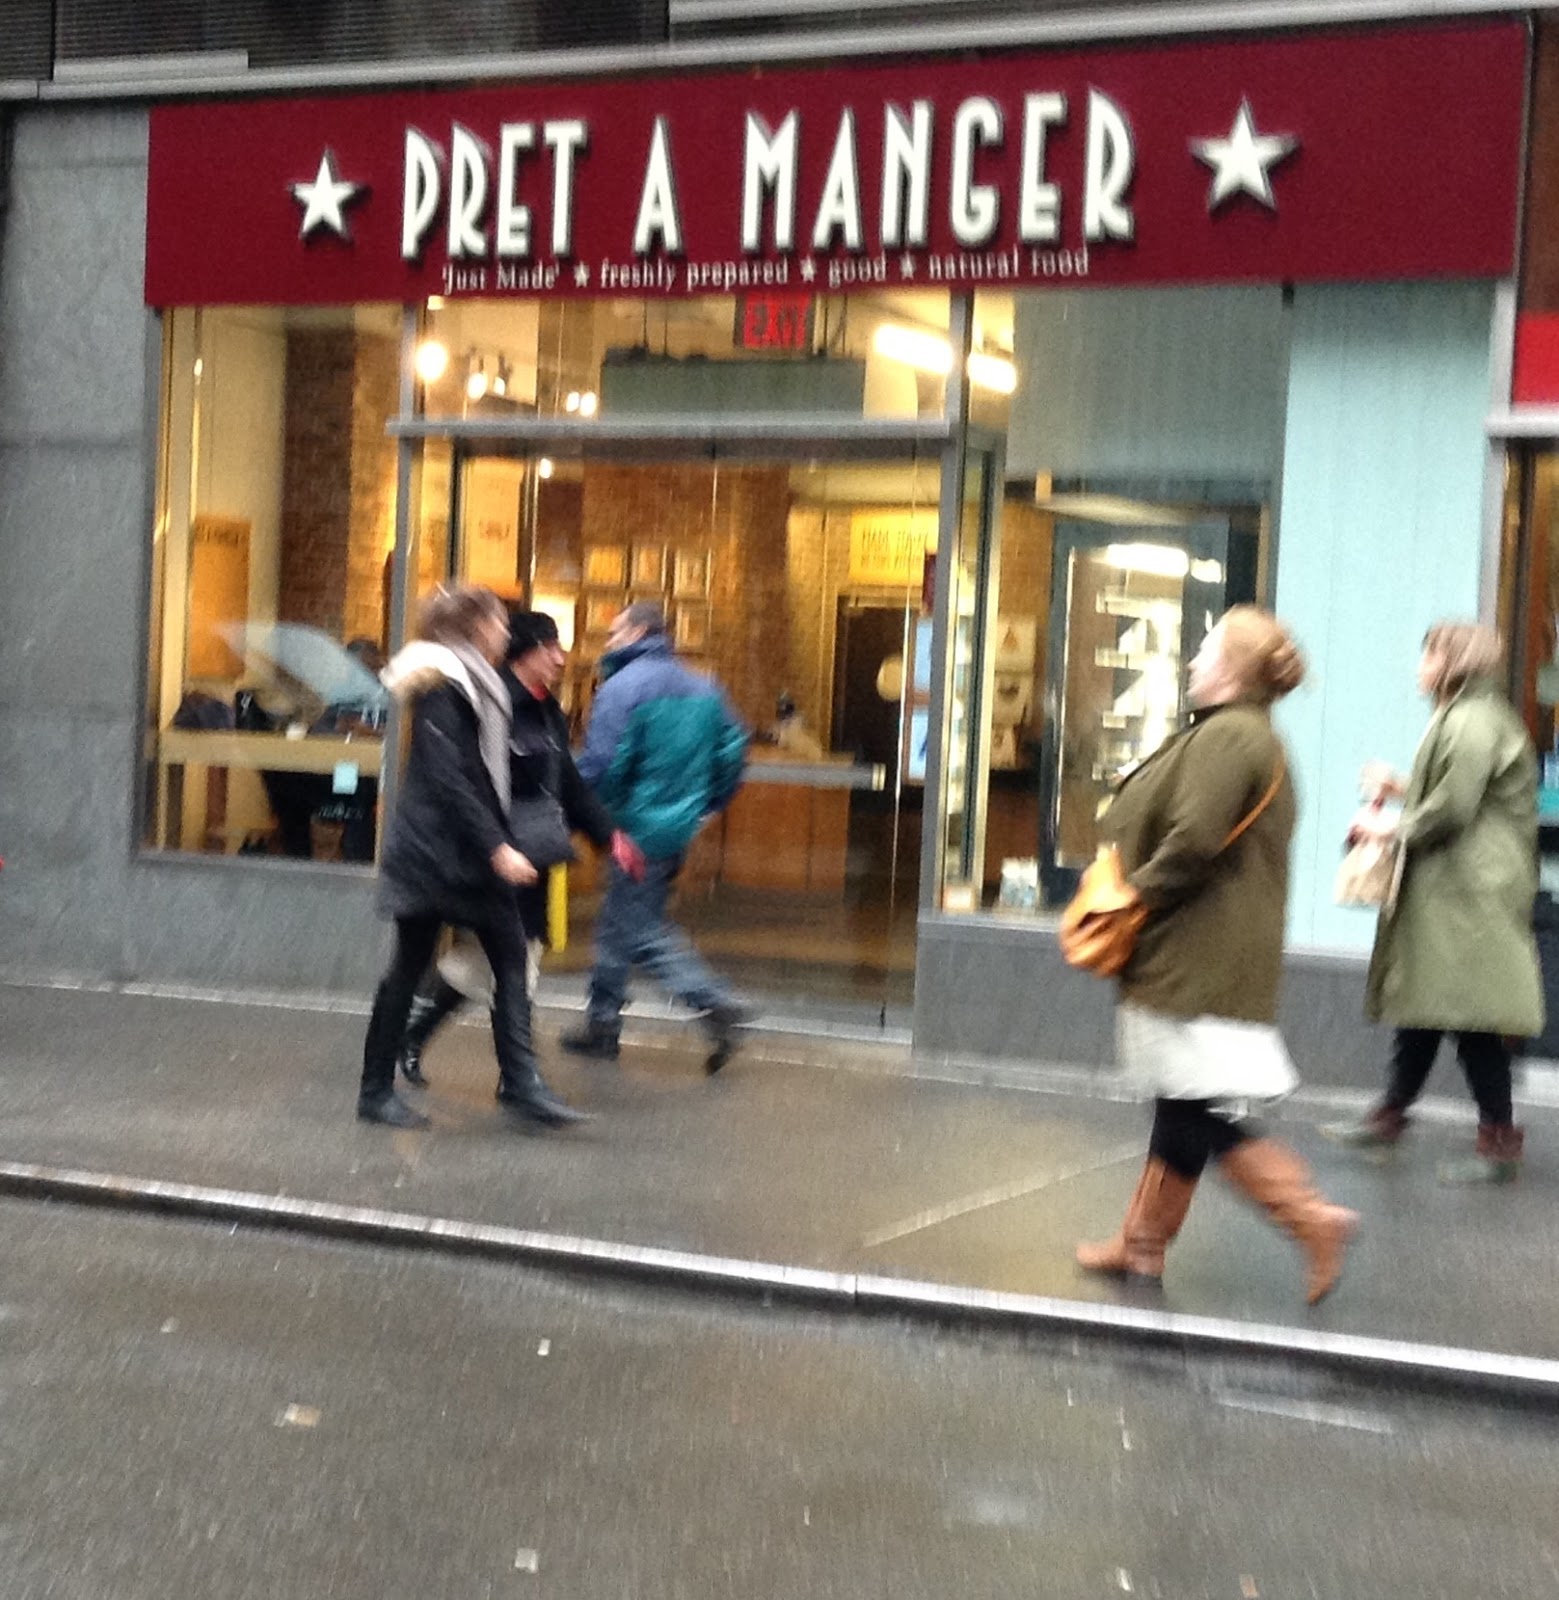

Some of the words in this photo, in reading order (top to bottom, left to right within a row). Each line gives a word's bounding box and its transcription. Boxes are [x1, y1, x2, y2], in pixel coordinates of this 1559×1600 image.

[402, 119, 589, 259] PRET
[633, 114, 683, 254] A
[740, 87, 1135, 253] MANGER
[600, 256, 676, 291] freshly
[686, 254, 789, 292] prepared
[829, 250, 887, 288] good
[929, 244, 1019, 280] natural
[1032, 246, 1090, 276] food
[743, 294, 808, 349] EXIT
